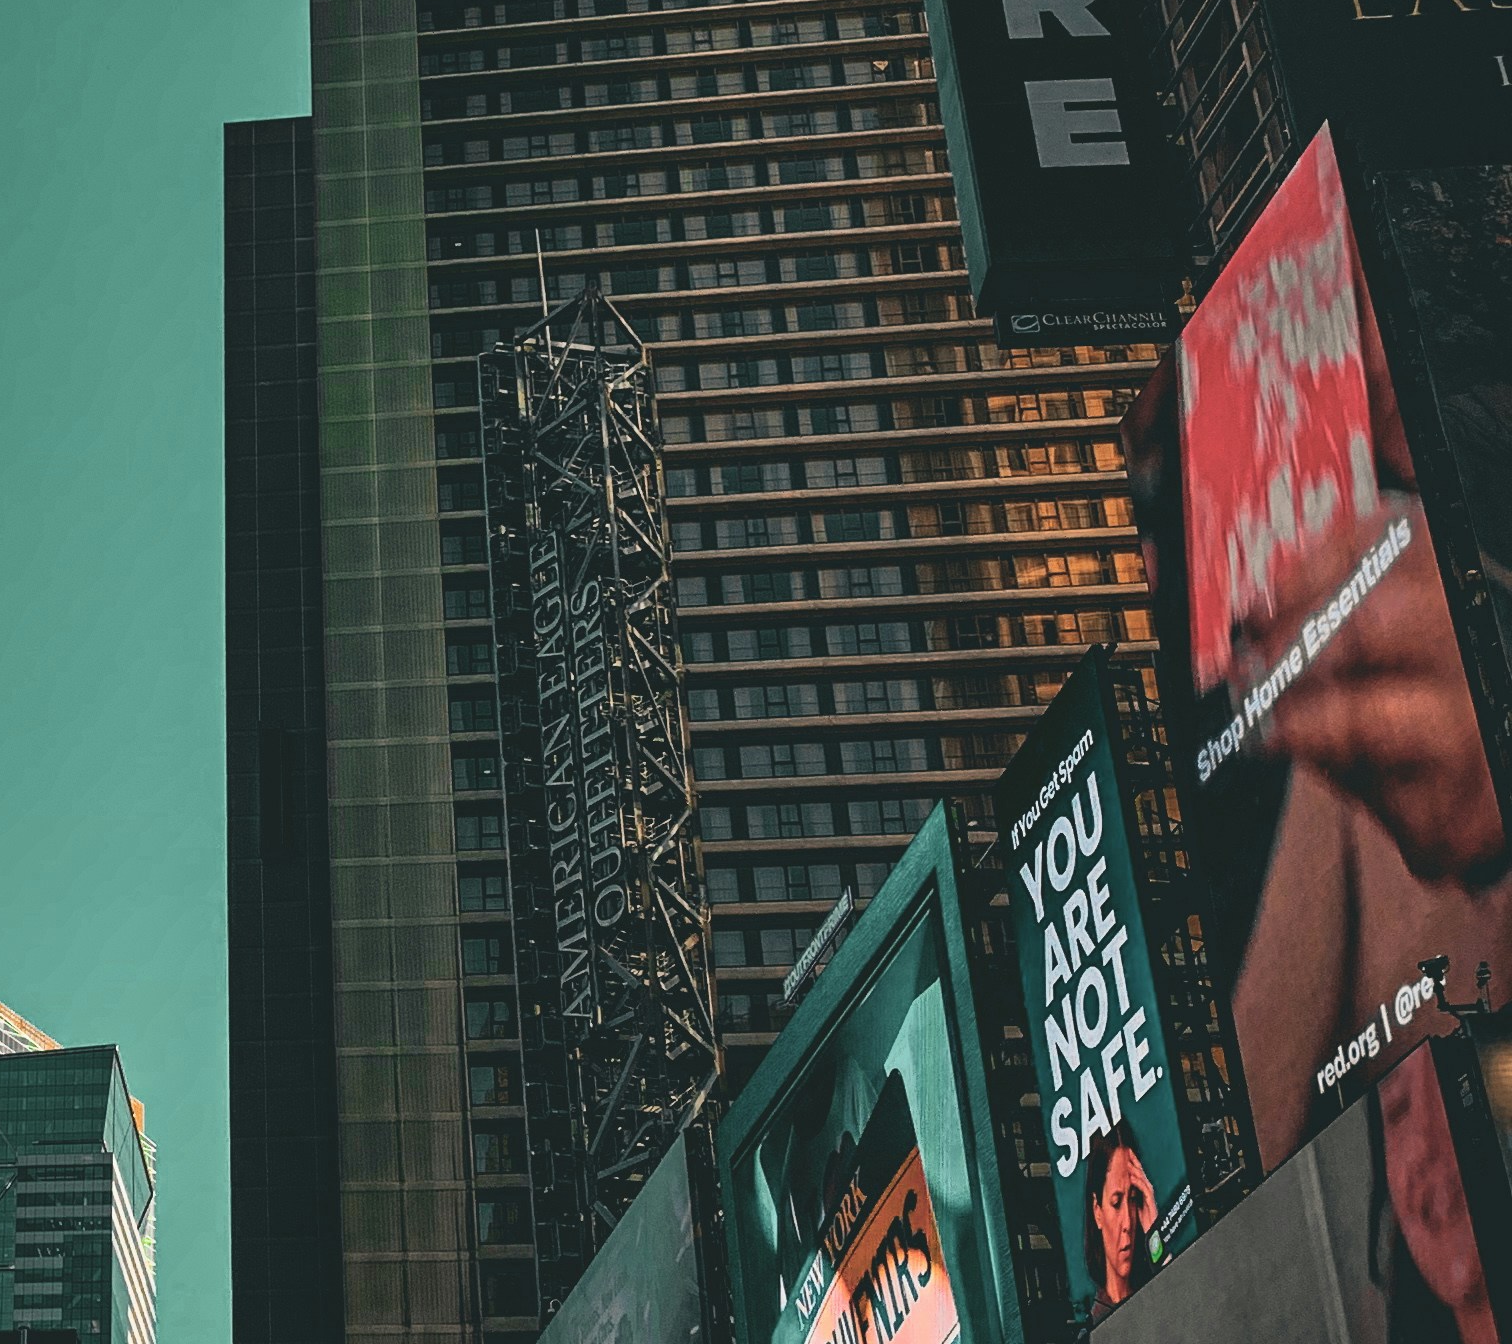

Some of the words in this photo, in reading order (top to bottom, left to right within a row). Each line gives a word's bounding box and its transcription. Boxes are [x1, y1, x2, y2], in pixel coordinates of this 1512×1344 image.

[532, 530, 567, 699] EAGLE
[1196, 713, 1245, 786] Shop
[1243, 653, 1304, 729] Home
[1301, 516, 1414, 660] Essentials
[570, 577, 624, 930] OUTFITTERS
[1011, 820, 1019, 851] If
[1018, 795, 1041, 839] You
[1039, 772, 1061, 813] Get
[1058, 729, 1094, 791] Spam
[540, 728, 593, 1025] AMERICAN
[1019, 771, 1103, 923] YOU
[1045, 856, 1117, 1007] ARE
[1045, 925, 1129, 1092] NOT
[1050, 1006, 1163, 1178] SAFE.
[1316, 1023, 1380, 1097] red.org
[795, 1249, 825, 1331] NEW
[823, 1166, 867, 1267] YORK
